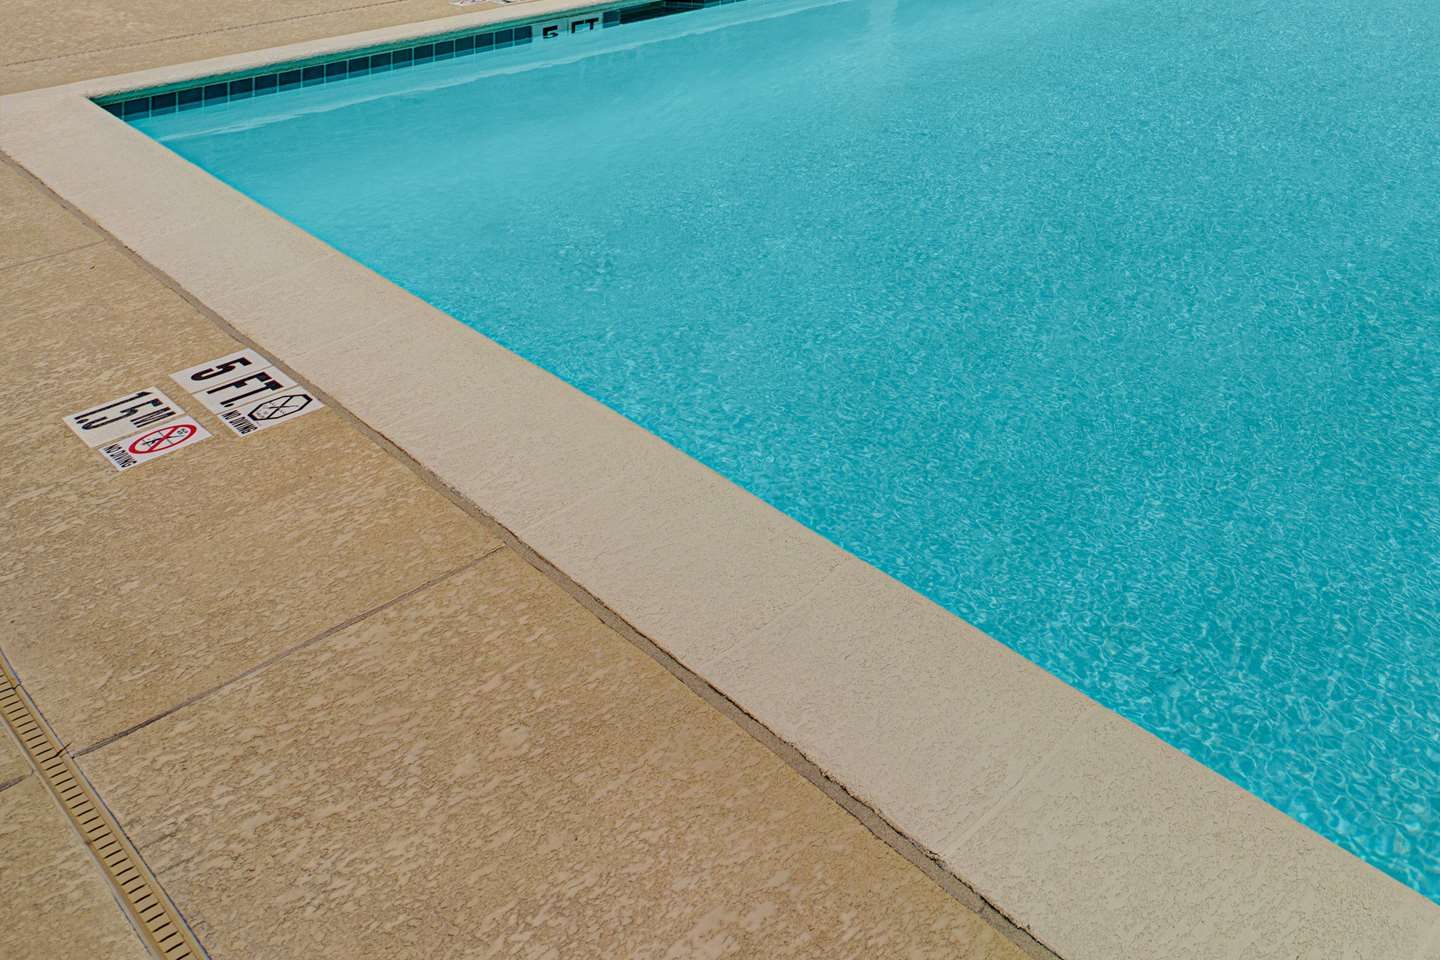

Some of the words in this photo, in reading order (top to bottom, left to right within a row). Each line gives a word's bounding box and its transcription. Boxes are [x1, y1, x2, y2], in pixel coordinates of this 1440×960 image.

[543, 25, 559, 39] 5
[190, 356, 253, 381] 5
[221, 409, 242, 420] NO
[228, 416, 258, 435] DIVING
[103, 443, 123, 454] NO
[110, 449, 137, 468] DIVING
